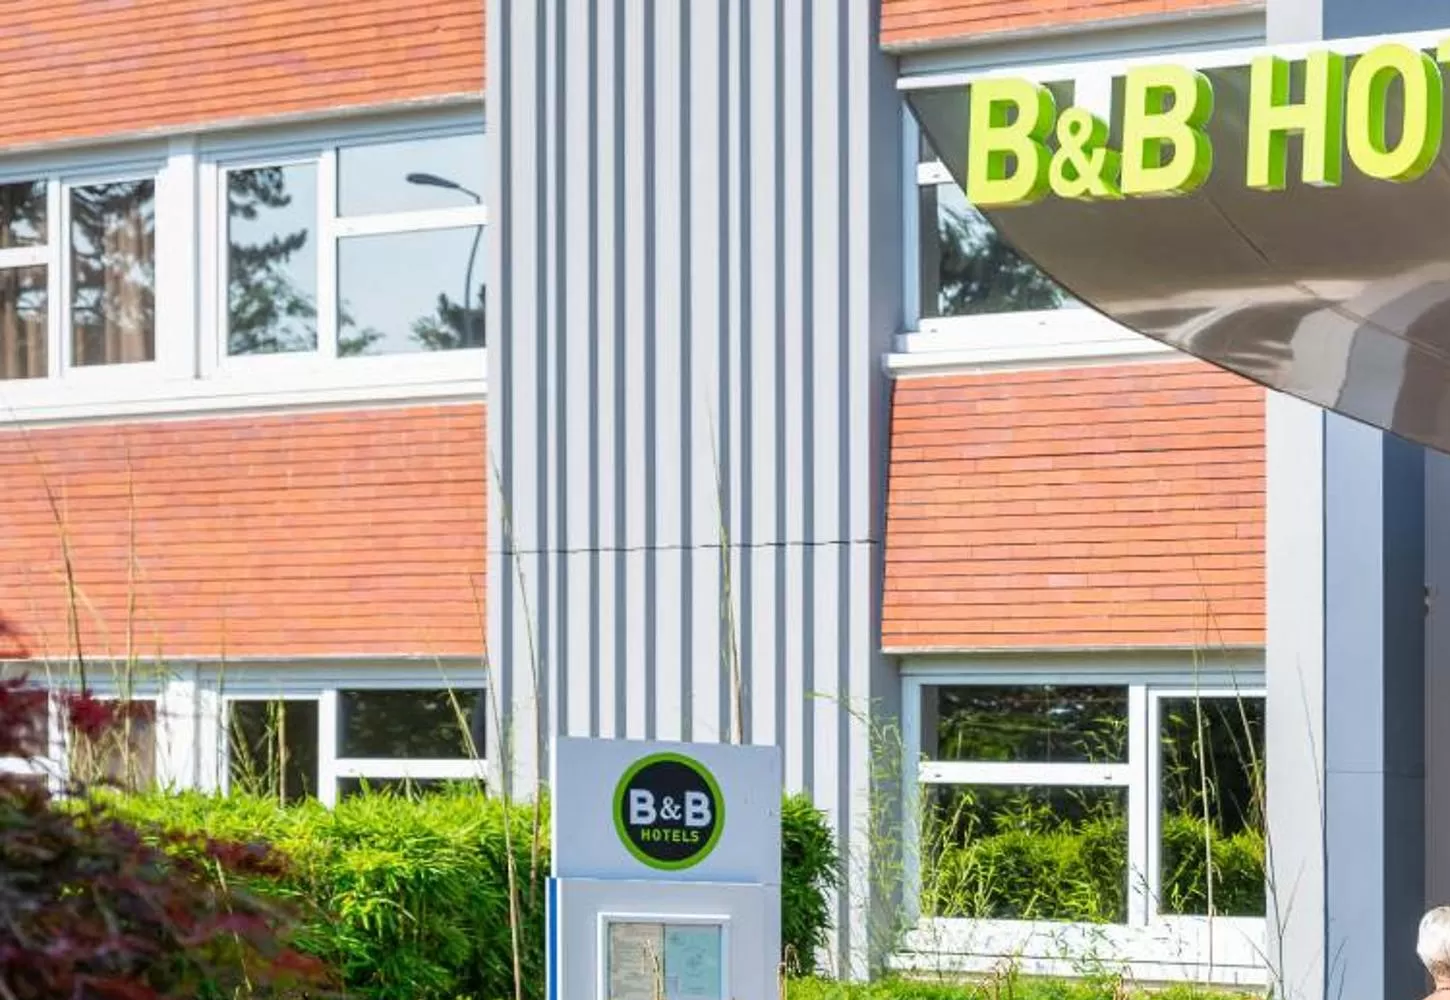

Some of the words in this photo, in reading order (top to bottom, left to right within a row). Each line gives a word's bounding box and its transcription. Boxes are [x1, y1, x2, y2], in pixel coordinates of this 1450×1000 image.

[966, 65, 1214, 206] B&B
[629, 788, 713, 827] B&B
[641, 828, 700, 843] HOTELS
